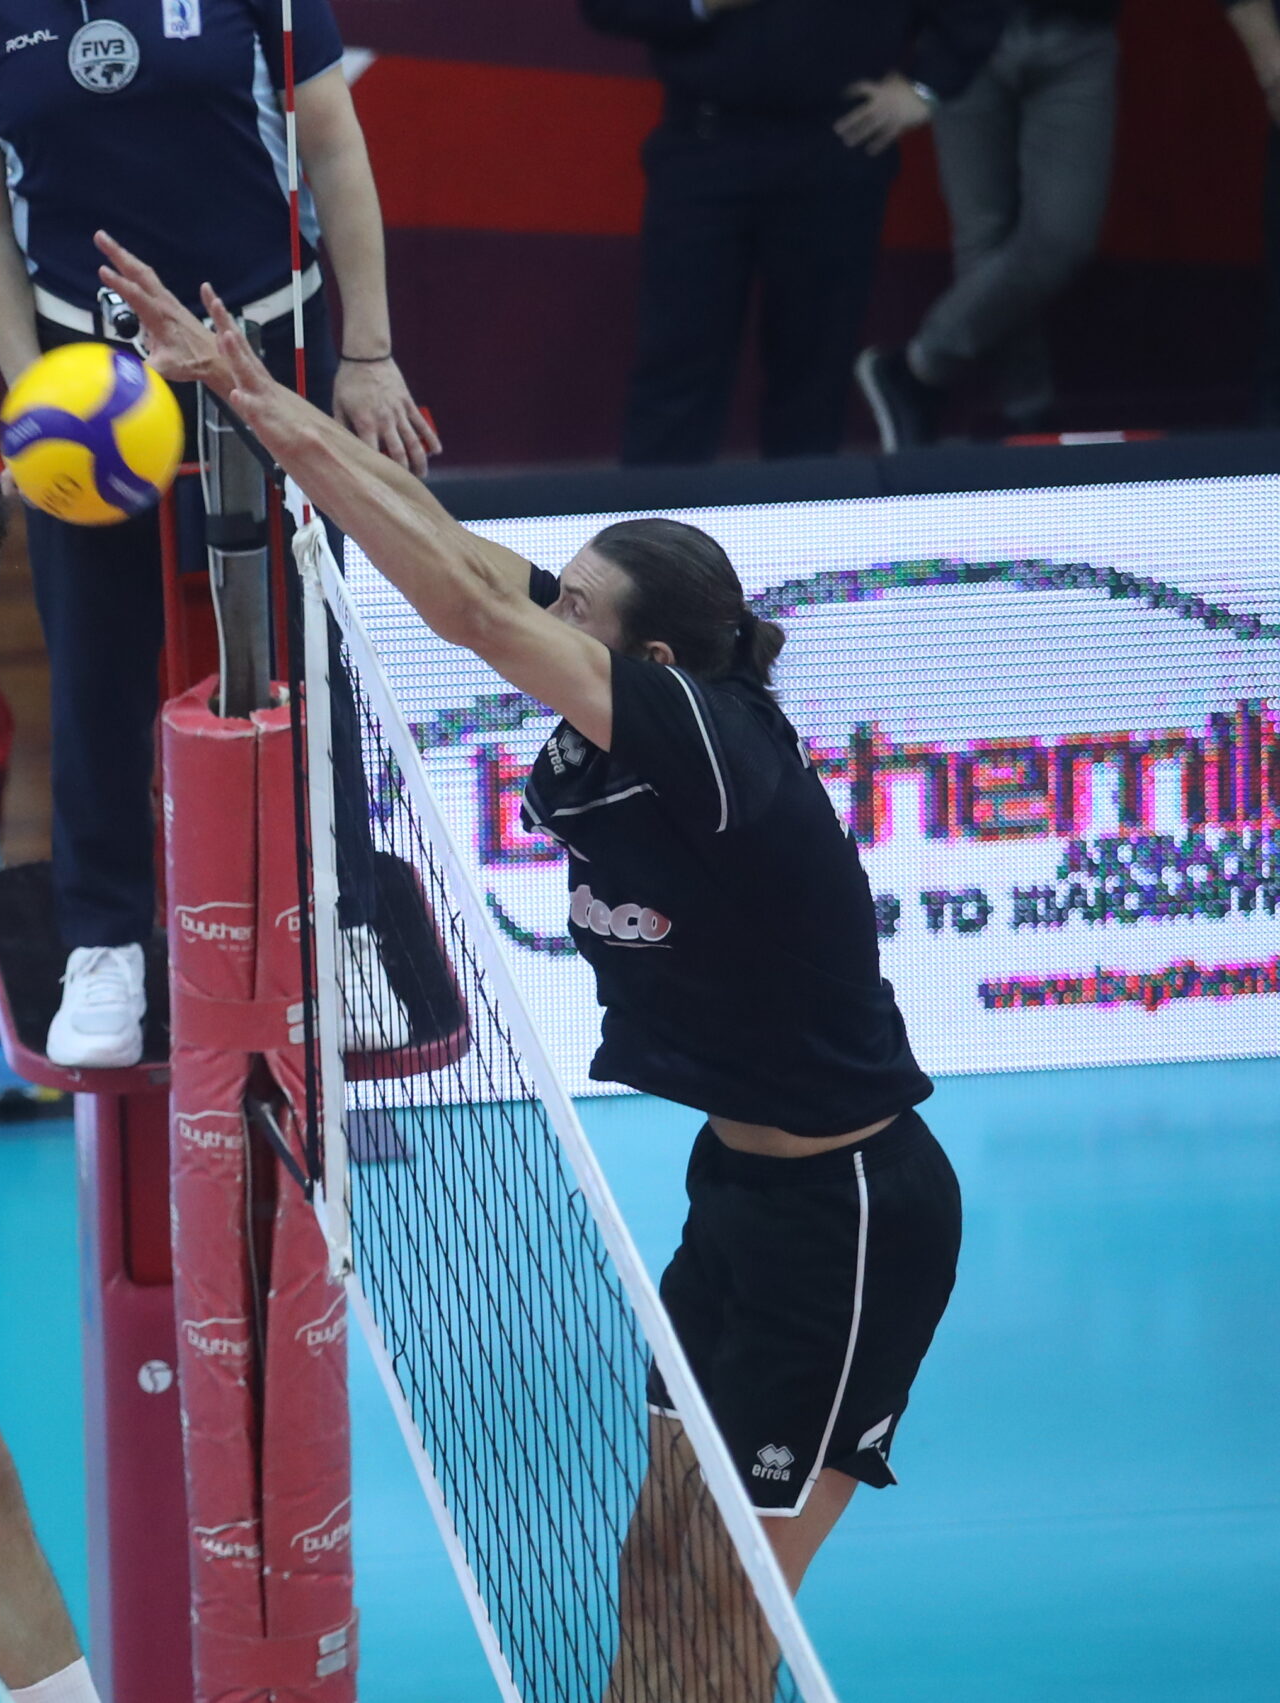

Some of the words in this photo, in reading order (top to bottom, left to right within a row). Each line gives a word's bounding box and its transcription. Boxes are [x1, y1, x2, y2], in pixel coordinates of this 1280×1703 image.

[81, 39, 125, 57] FIVB
[546, 736, 567, 776] errea
[752, 1463, 791, 1481] errea
